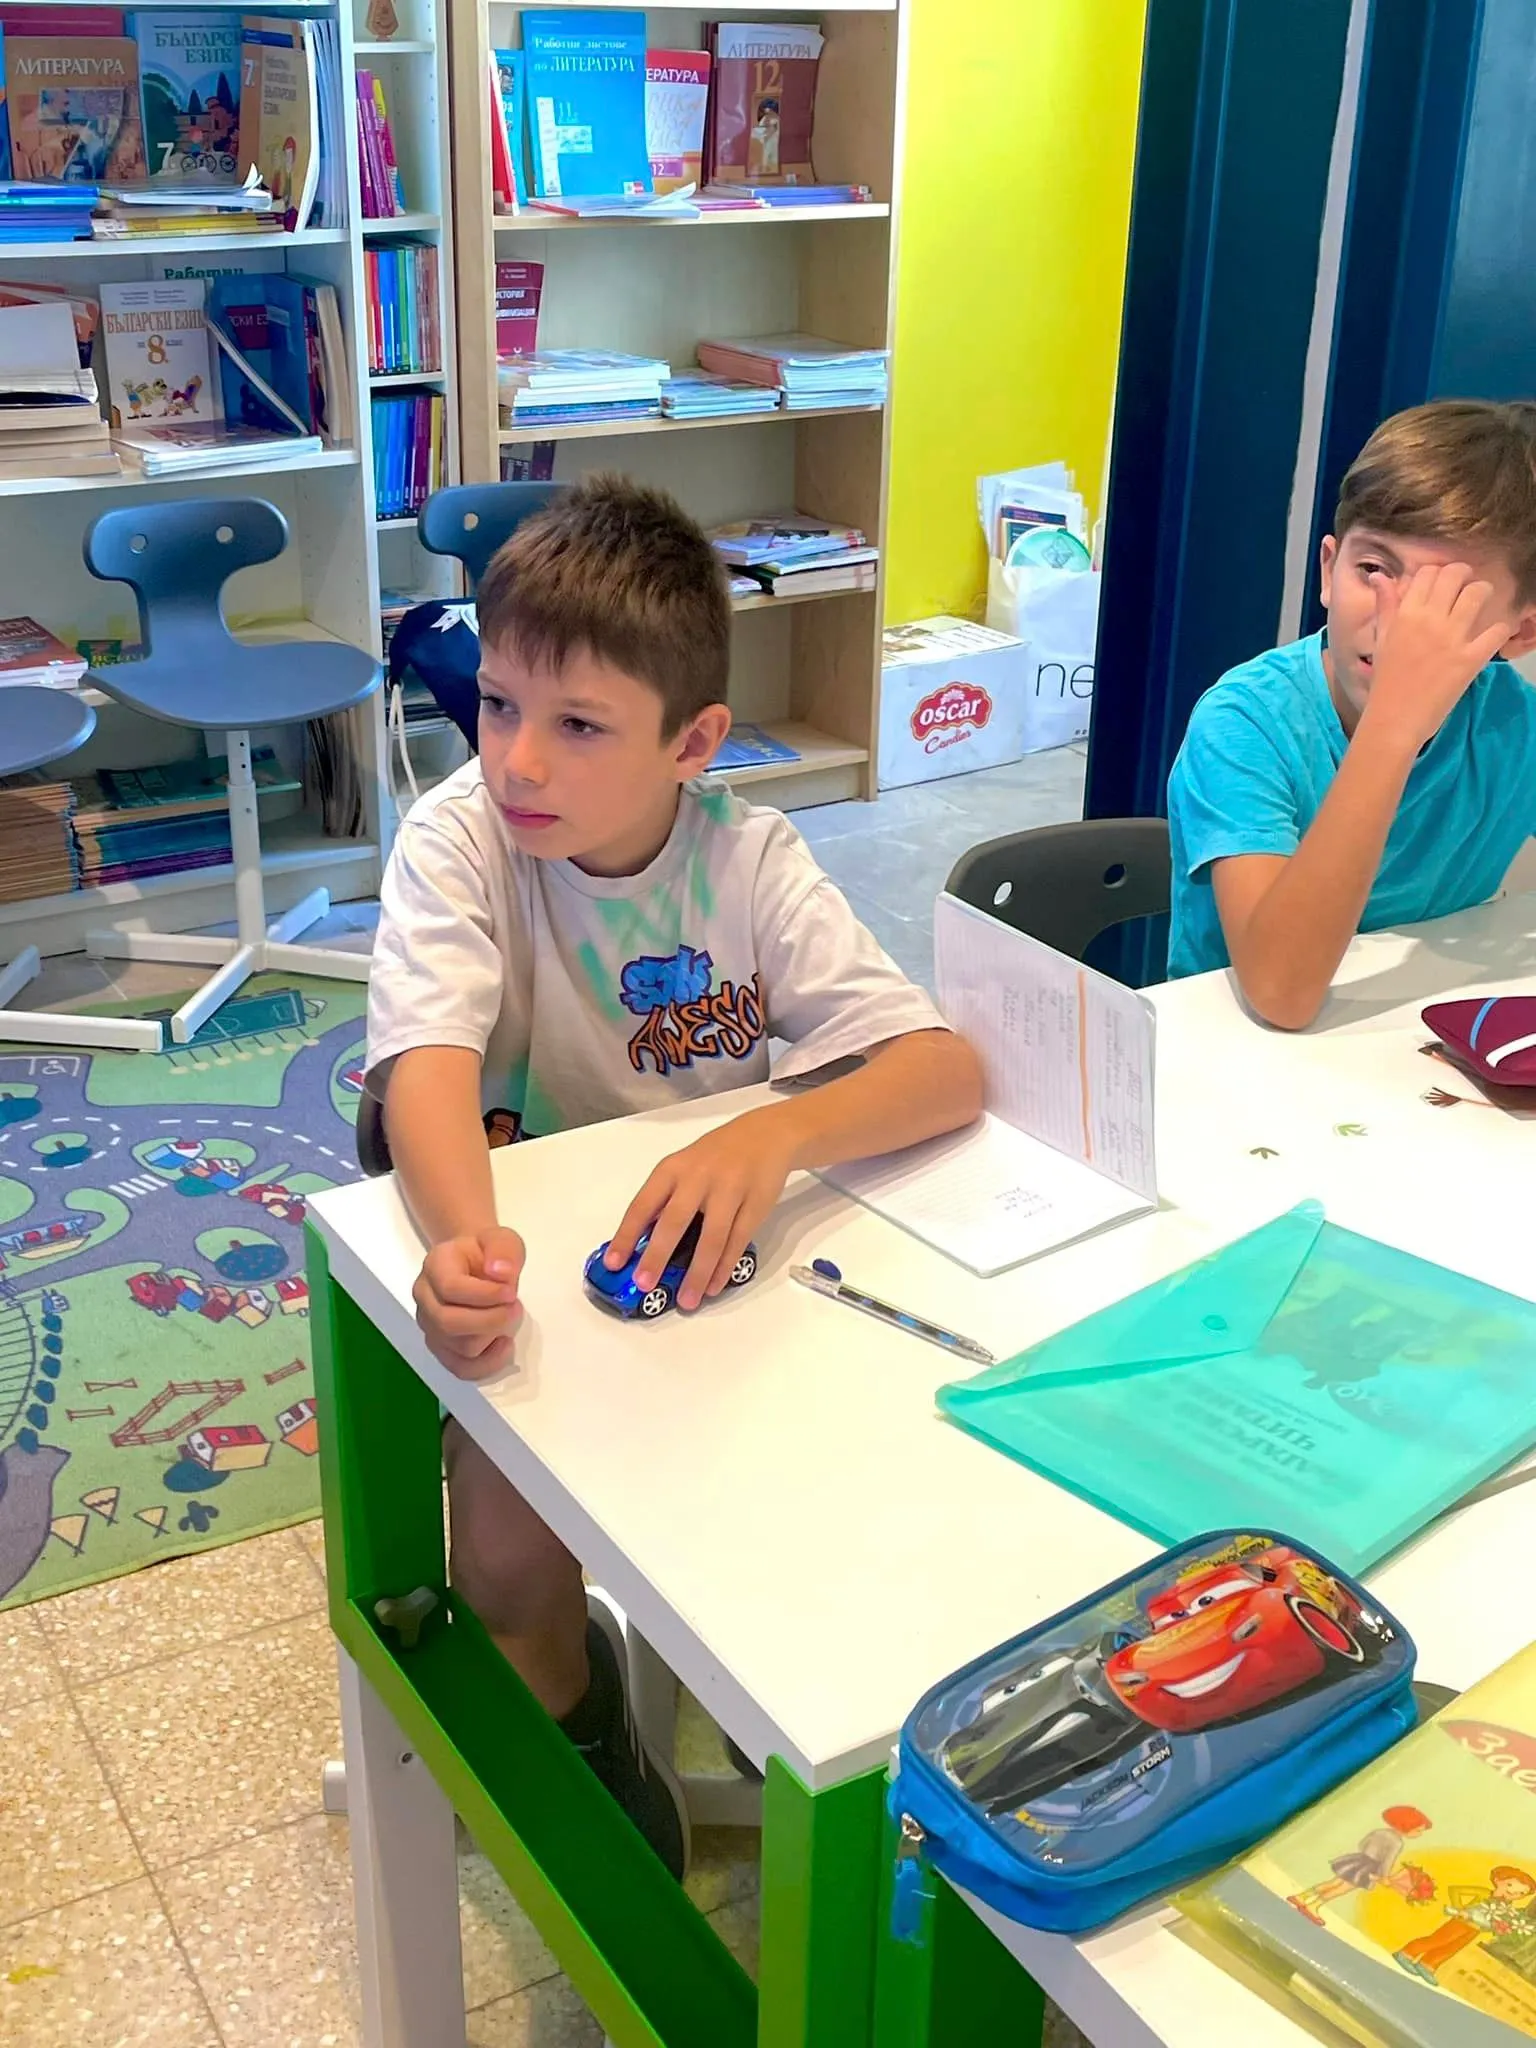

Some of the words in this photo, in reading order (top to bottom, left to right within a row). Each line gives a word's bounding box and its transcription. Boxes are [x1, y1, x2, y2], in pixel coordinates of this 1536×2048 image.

[155, 32, 240, 47] БЪЛГАРС
[185, 47, 233, 63] ЕЗИК
[727, 43, 812, 58] ЛИТЕРАТУРА
[15, 57, 126, 76] ЛИТЕРАТУРА
[551, 56, 636, 72] ЛИТЕРАТУРА
[106, 312, 172, 333] БЪЛГАРСКИ
[920, 698, 981, 726] oscar
[1131, 1746, 1171, 1778] STORM
